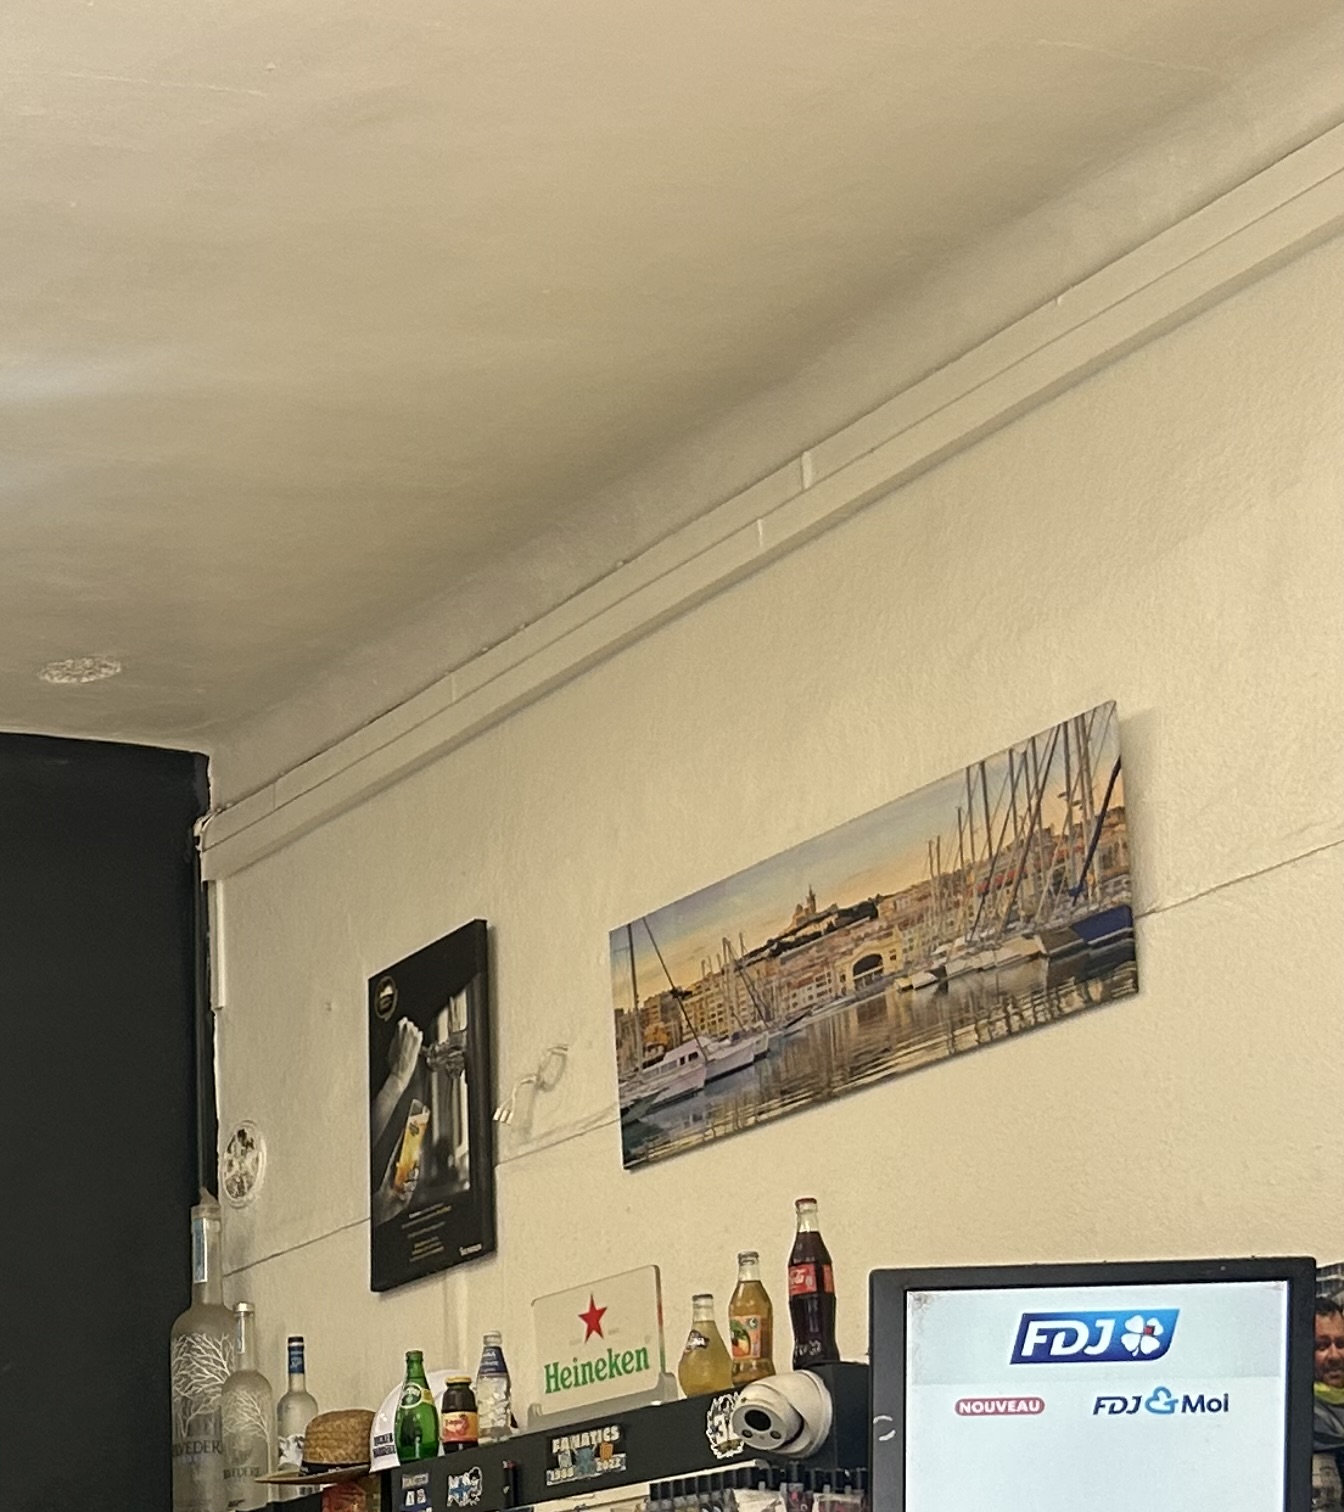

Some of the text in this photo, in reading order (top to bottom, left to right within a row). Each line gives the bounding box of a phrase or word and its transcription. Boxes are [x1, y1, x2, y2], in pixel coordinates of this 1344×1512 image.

[1020, 1318, 1116, 1357] FDJ
[543, 1346, 650, 1394] Heineken
[958, 1398, 1042, 1413] NOUVEAU
[1092, 1395, 1144, 1415] FDJ
[1181, 1391, 1230, 1414] Moi
